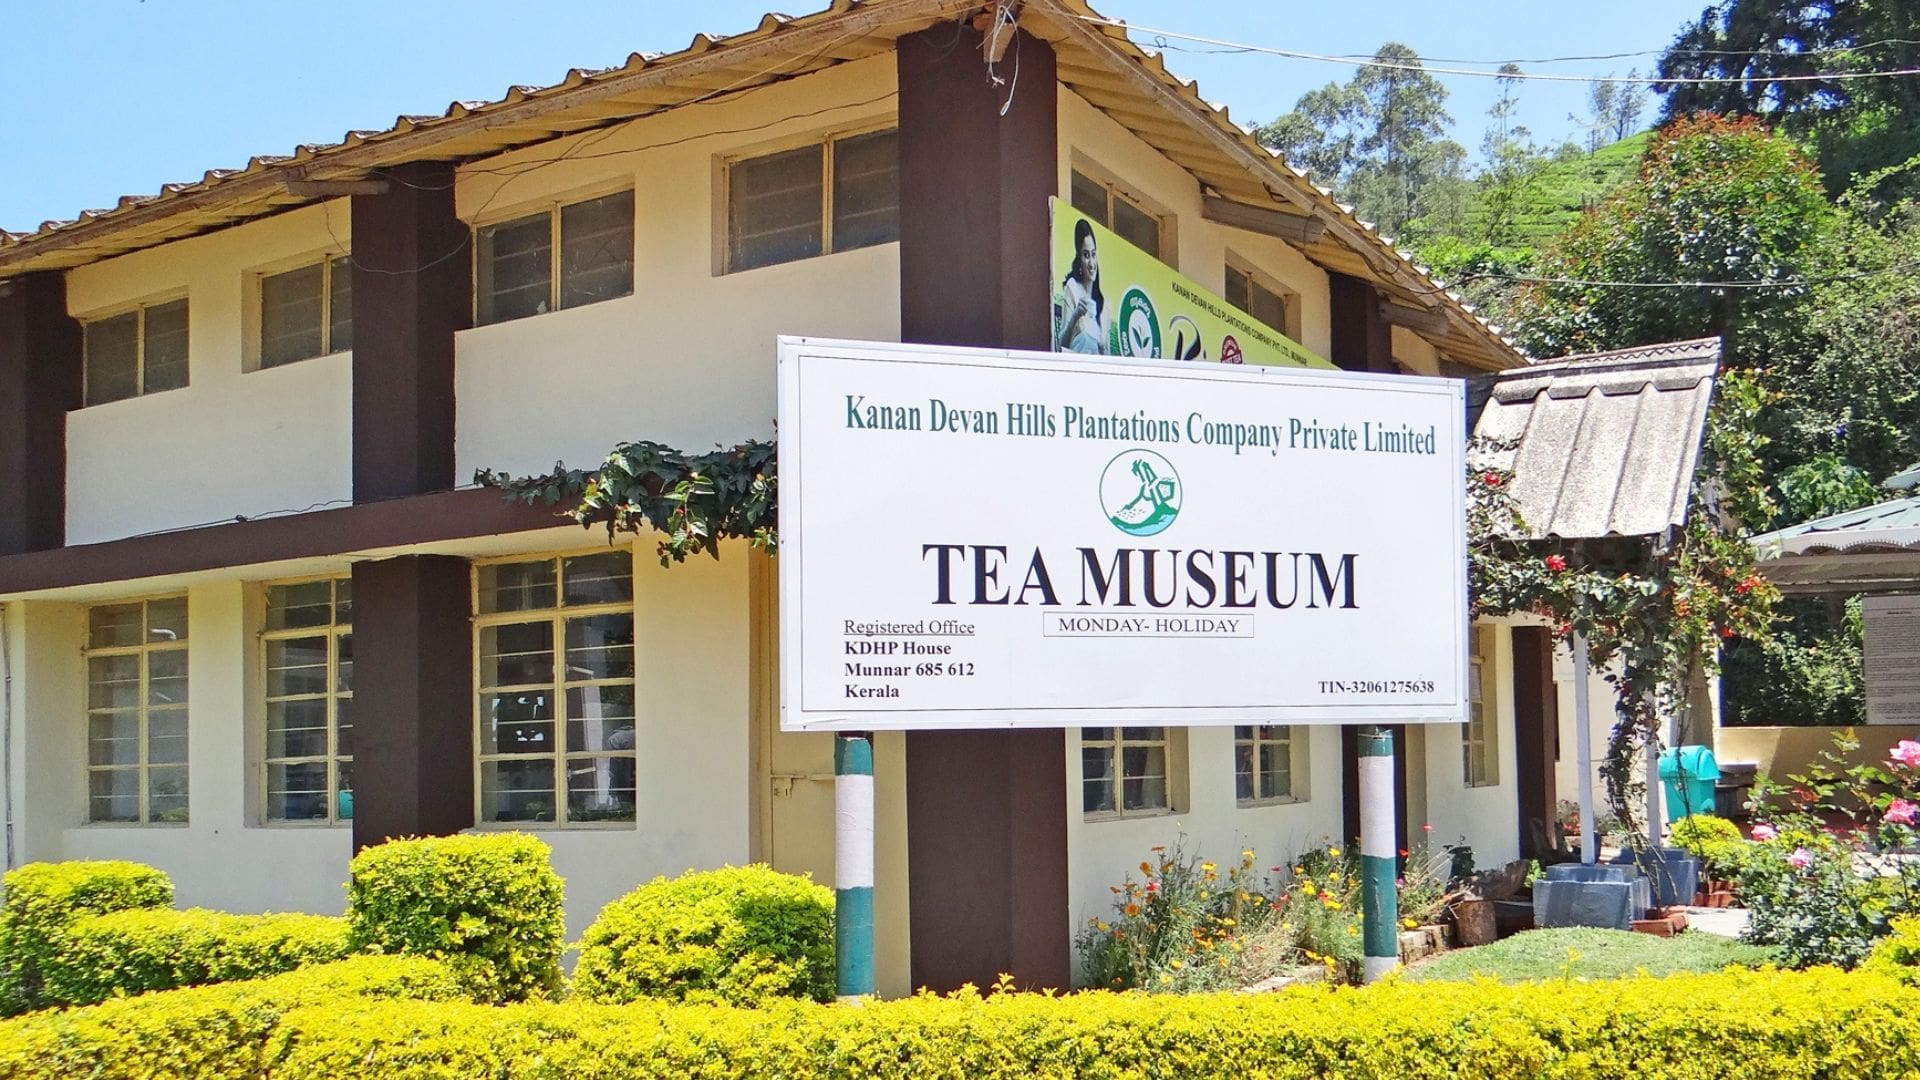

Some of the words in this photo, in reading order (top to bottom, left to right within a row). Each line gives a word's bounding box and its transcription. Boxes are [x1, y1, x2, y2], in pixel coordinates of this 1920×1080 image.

[1172, 281, 1190, 300] KANAN
[1191, 292, 1207, 309] DEVAN
[1207, 303, 1221, 318] HILLS
[1221, 311, 1251, 336] PLANTATIONS
[1252, 328, 1271, 345] COMPANY
[845, 394, 922, 431] Kanan
[929, 398, 999, 435] Devan
[1006, 402, 1056, 438] Hills
[1063, 405, 1180, 443] Plantations
[1186, 412, 1281, 457] Company
[1289, 418, 1358, 452] Private
[1364, 421, 1436, 455] Limited
[921, 543, 1062, 606] TEA
[1075, 546, 1360, 610] MUSEUM
[844, 619, 924, 637] Registered
[928, 620, 976, 635] Office
[1059, 617, 1150, 632] MONDAY-
[1156, 619, 1240, 633] HOLIDAY
[845, 641, 899, 655] KDHP
[903, 641, 952, 655] House
[845, 662, 912, 677] Munnar
[916, 662, 943, 677] 685
[948, 662, 975, 676] 612
[845, 684, 900, 698] Kerala
[1318, 680, 1435, 694] TIN-32061275638
